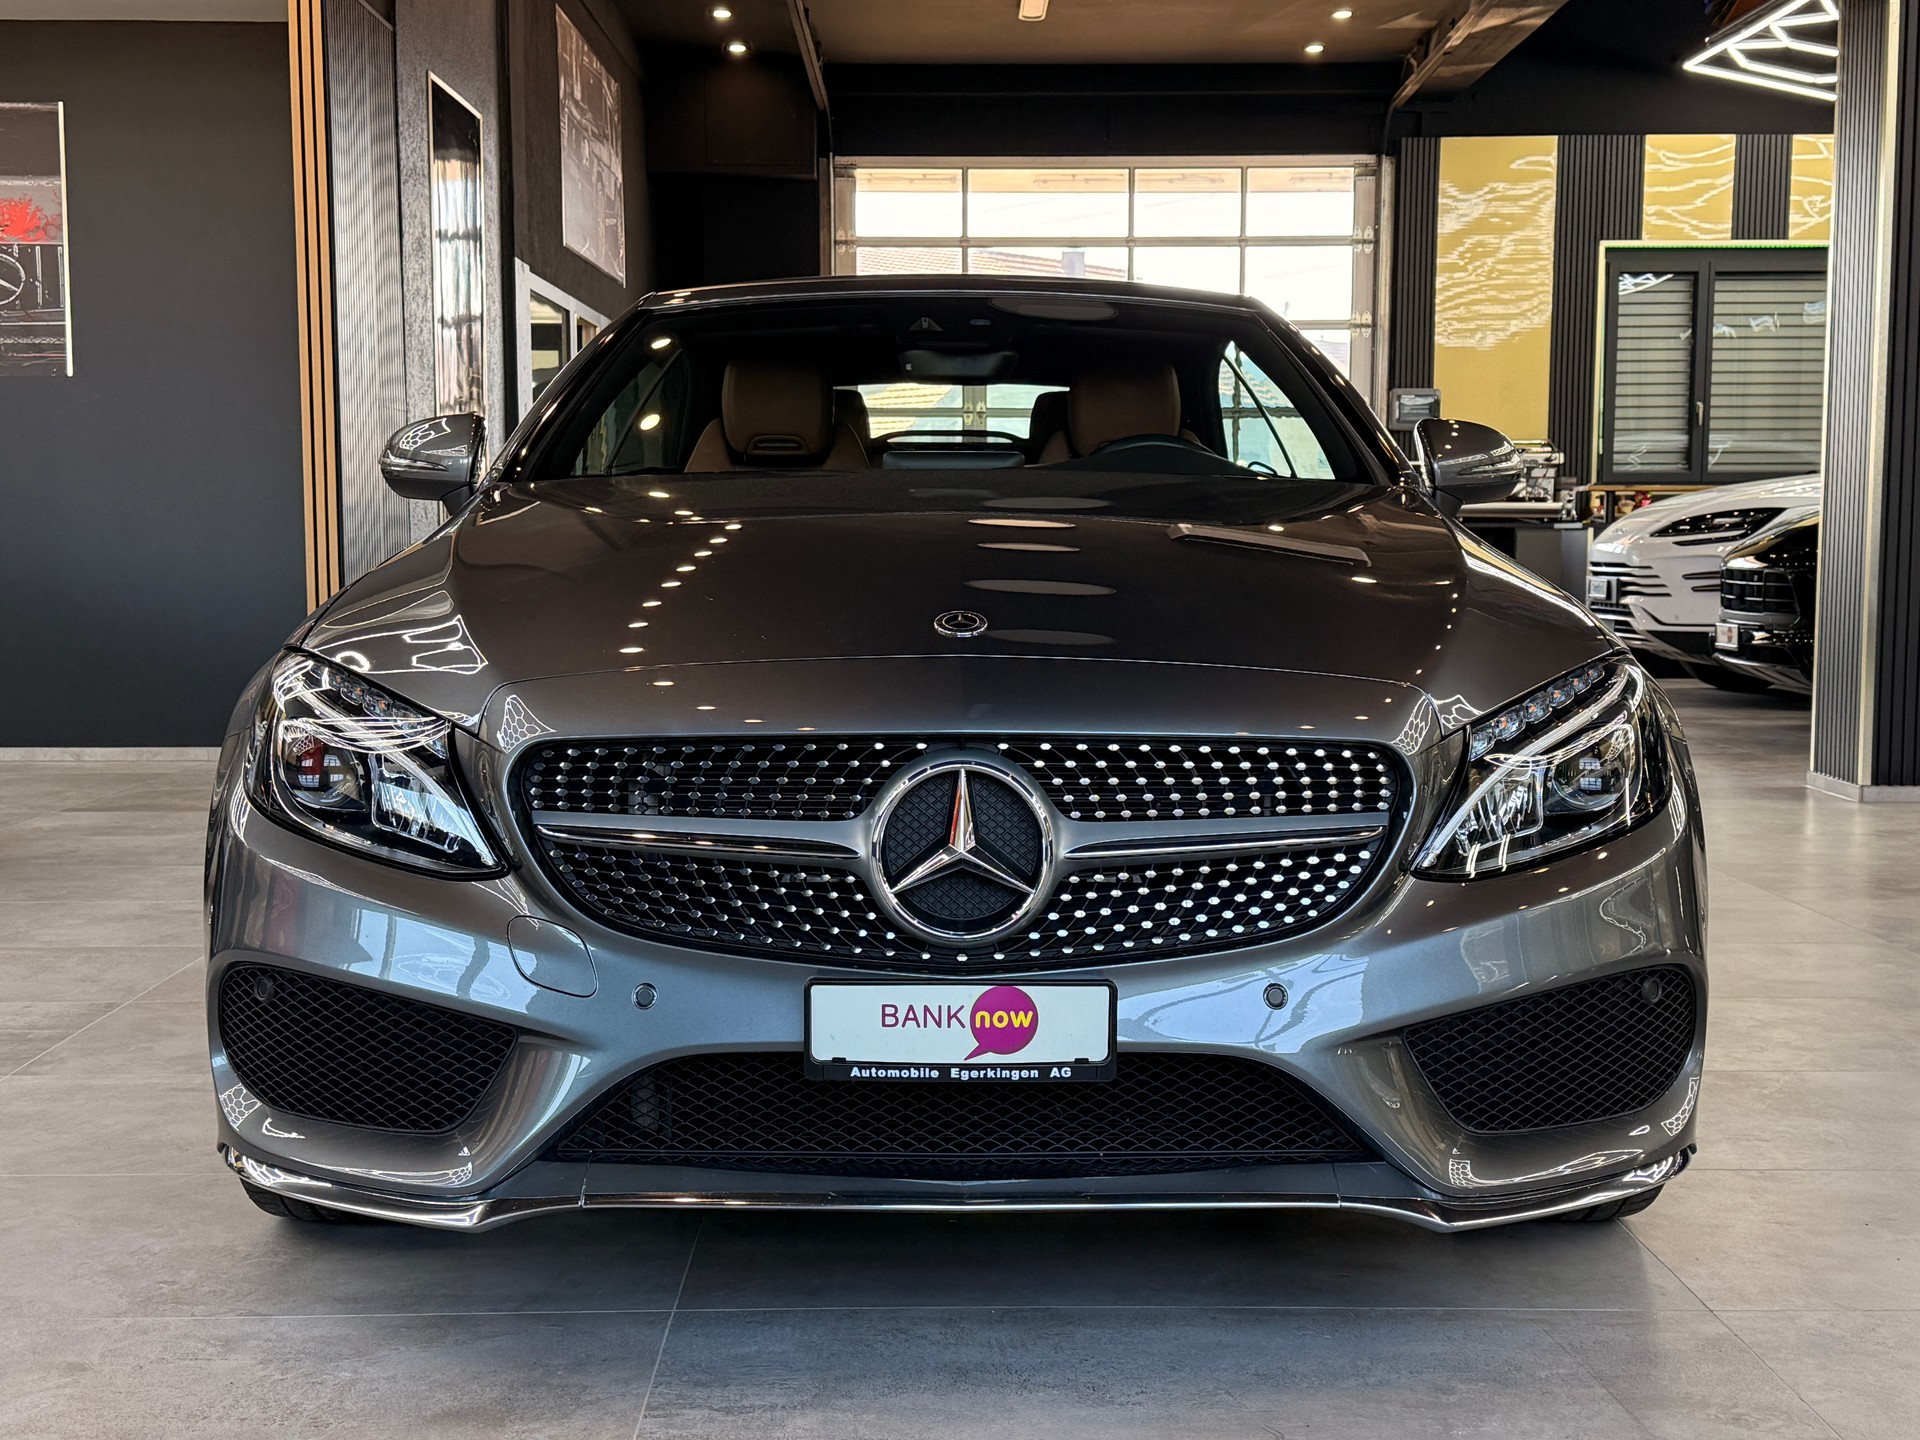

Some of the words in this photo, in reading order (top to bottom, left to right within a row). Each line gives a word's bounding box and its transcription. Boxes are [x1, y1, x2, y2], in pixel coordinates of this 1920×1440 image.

[881, 1004, 966, 1028] BANK
[975, 1010, 1033, 1028] now
[850, 1066, 939, 1079] Automobile
[950, 1067, 1039, 1080] Egerkingen
[1049, 1066, 1072, 1078] AG
